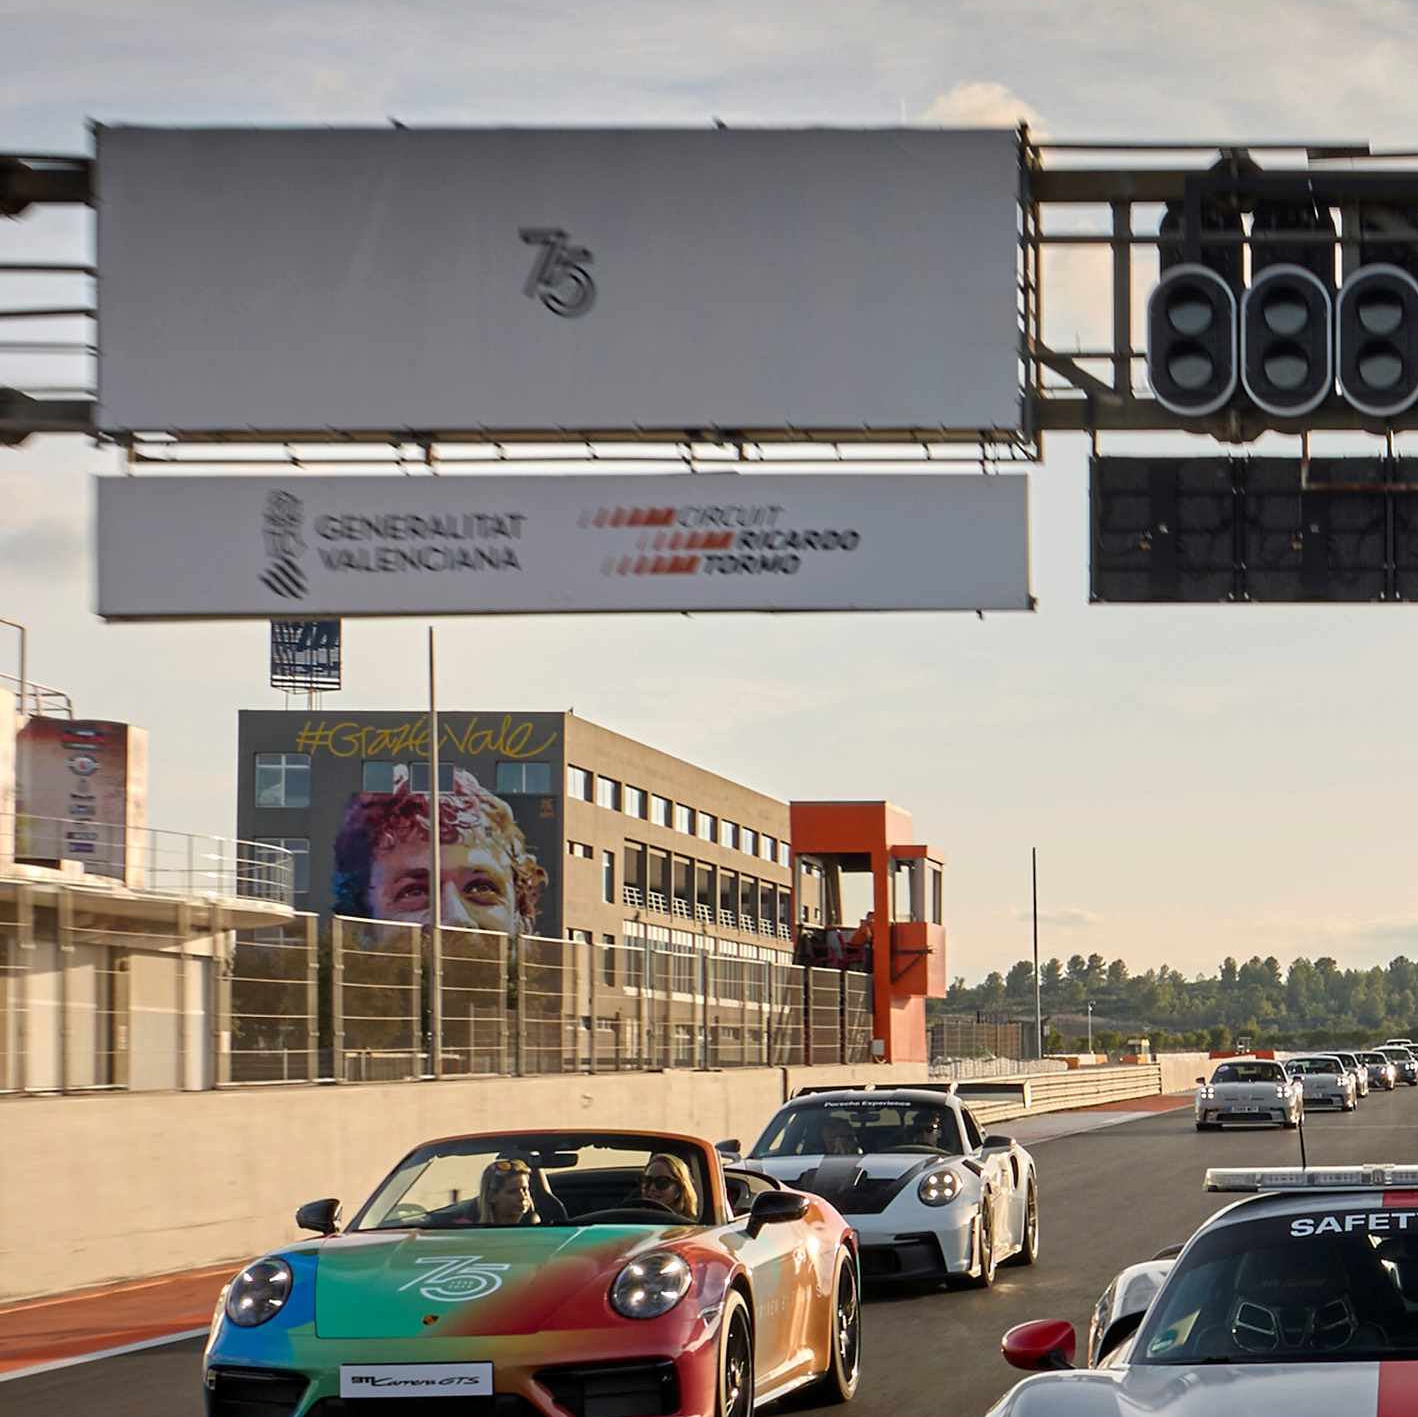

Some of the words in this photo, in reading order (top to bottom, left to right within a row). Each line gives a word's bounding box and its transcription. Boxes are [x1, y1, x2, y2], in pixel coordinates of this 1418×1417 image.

[314, 513, 527, 542] GENERALITAT
[677, 504, 784, 529] CIRCUIT
[737, 529, 860, 553] RICARDO
[317, 546, 523, 575] VALENCIANA
[702, 553, 801, 576] TORMO
[438, 1376, 480, 1386] GTS
